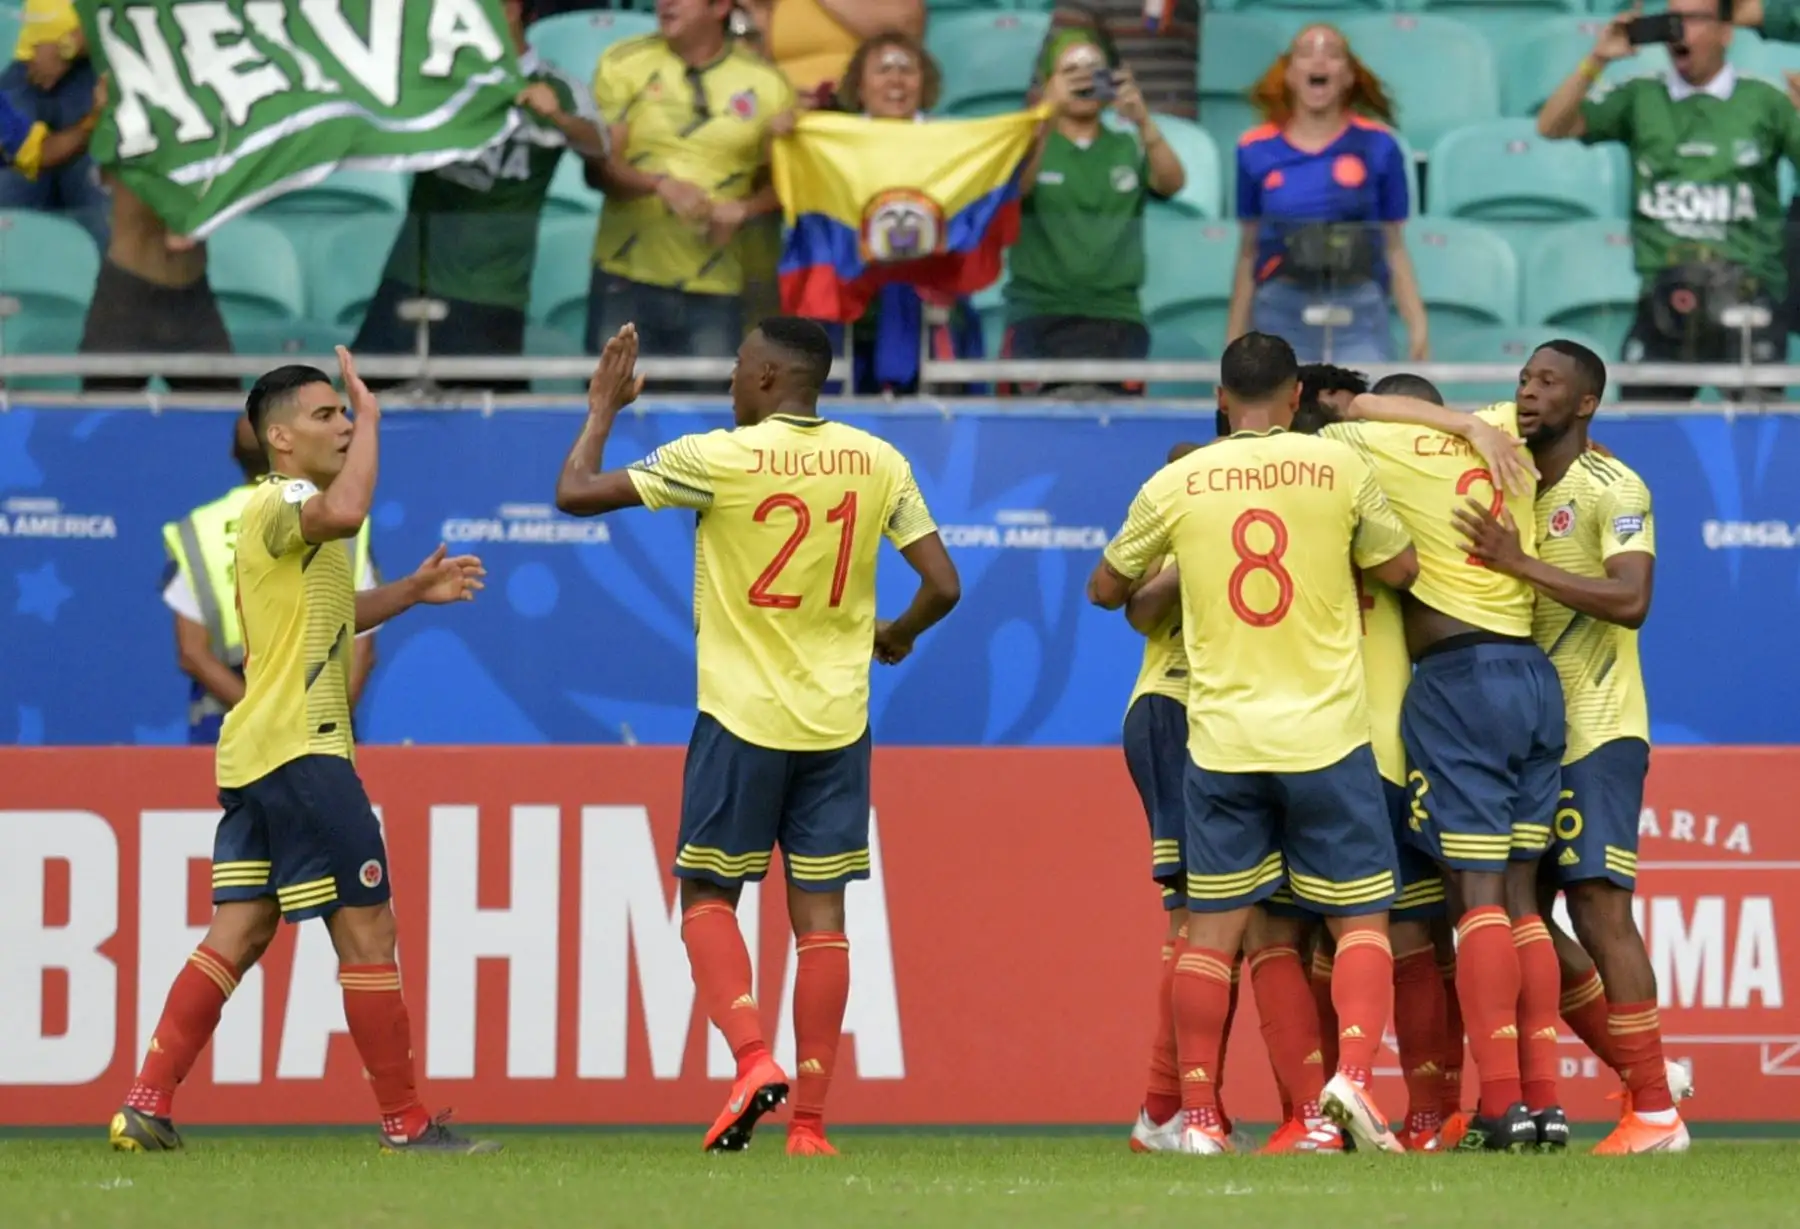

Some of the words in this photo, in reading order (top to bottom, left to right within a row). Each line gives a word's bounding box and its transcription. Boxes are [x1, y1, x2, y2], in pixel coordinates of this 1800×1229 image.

[97, 0, 503, 158] NEIVA
[441, 518, 505, 543] COPA
[1186, 460, 1335, 496] E.CARDONA
[748, 491, 857, 609] 21
[1228, 508, 1294, 628] 8
